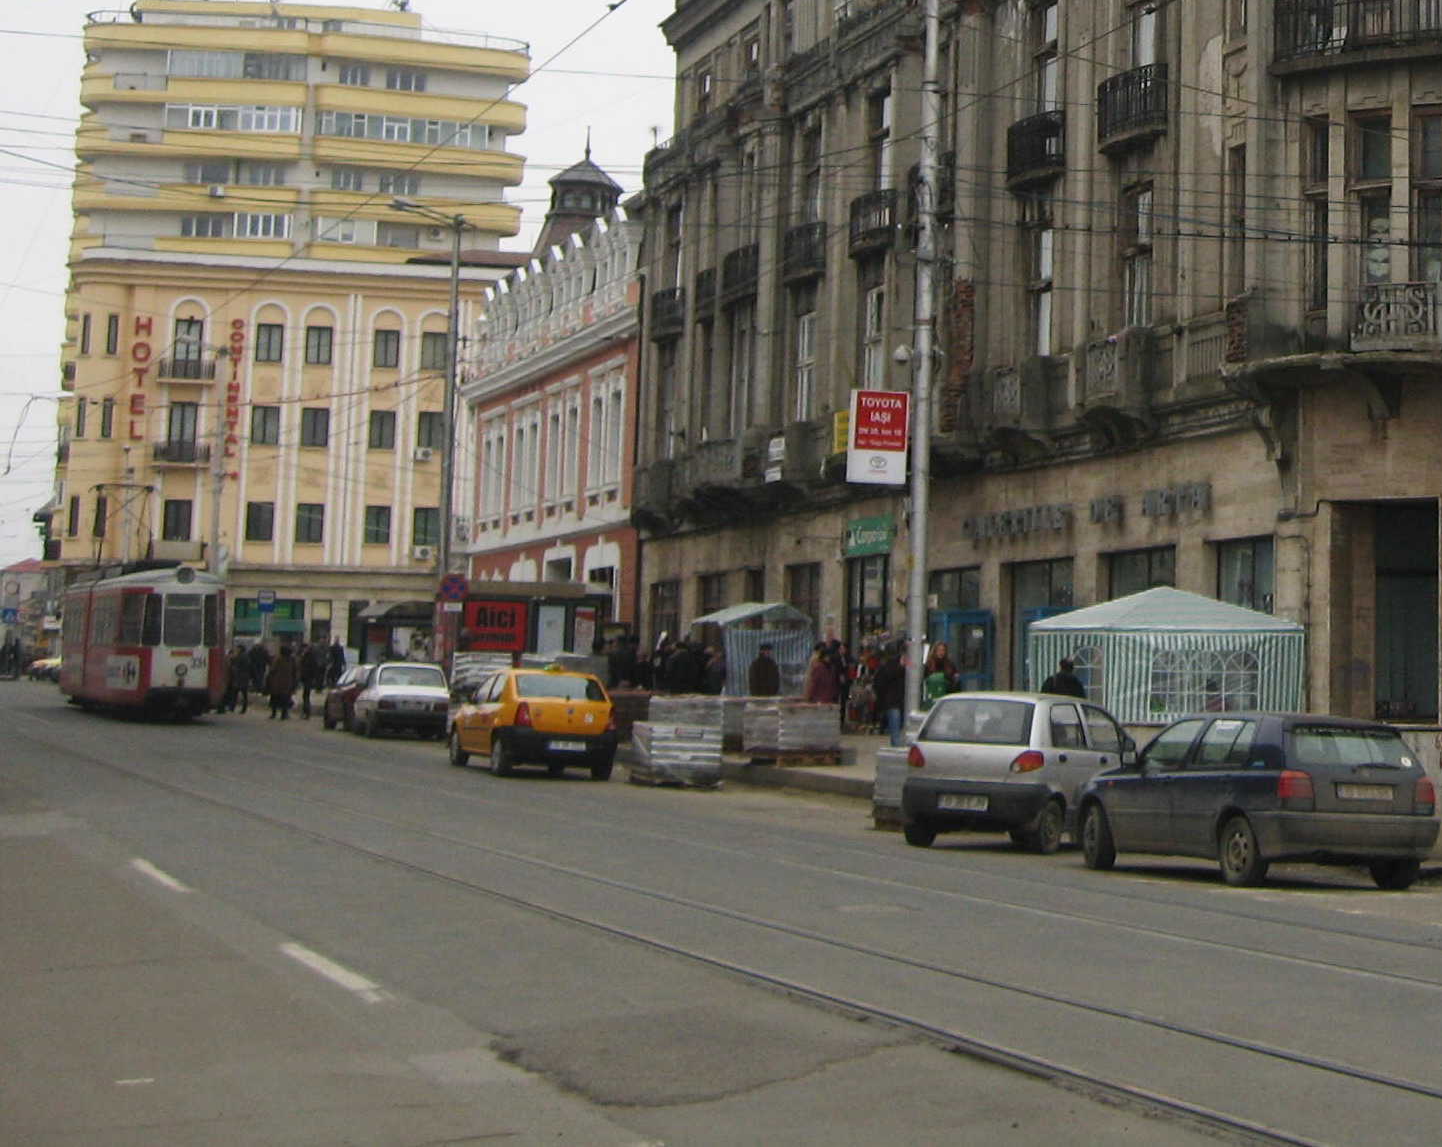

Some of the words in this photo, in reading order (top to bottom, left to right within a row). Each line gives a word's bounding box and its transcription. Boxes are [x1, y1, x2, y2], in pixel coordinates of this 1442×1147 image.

[129, 316, 152, 441] HOTEL
[861, 397, 902, 410] TOYOTA
[476, 606, 516, 628] Aici
